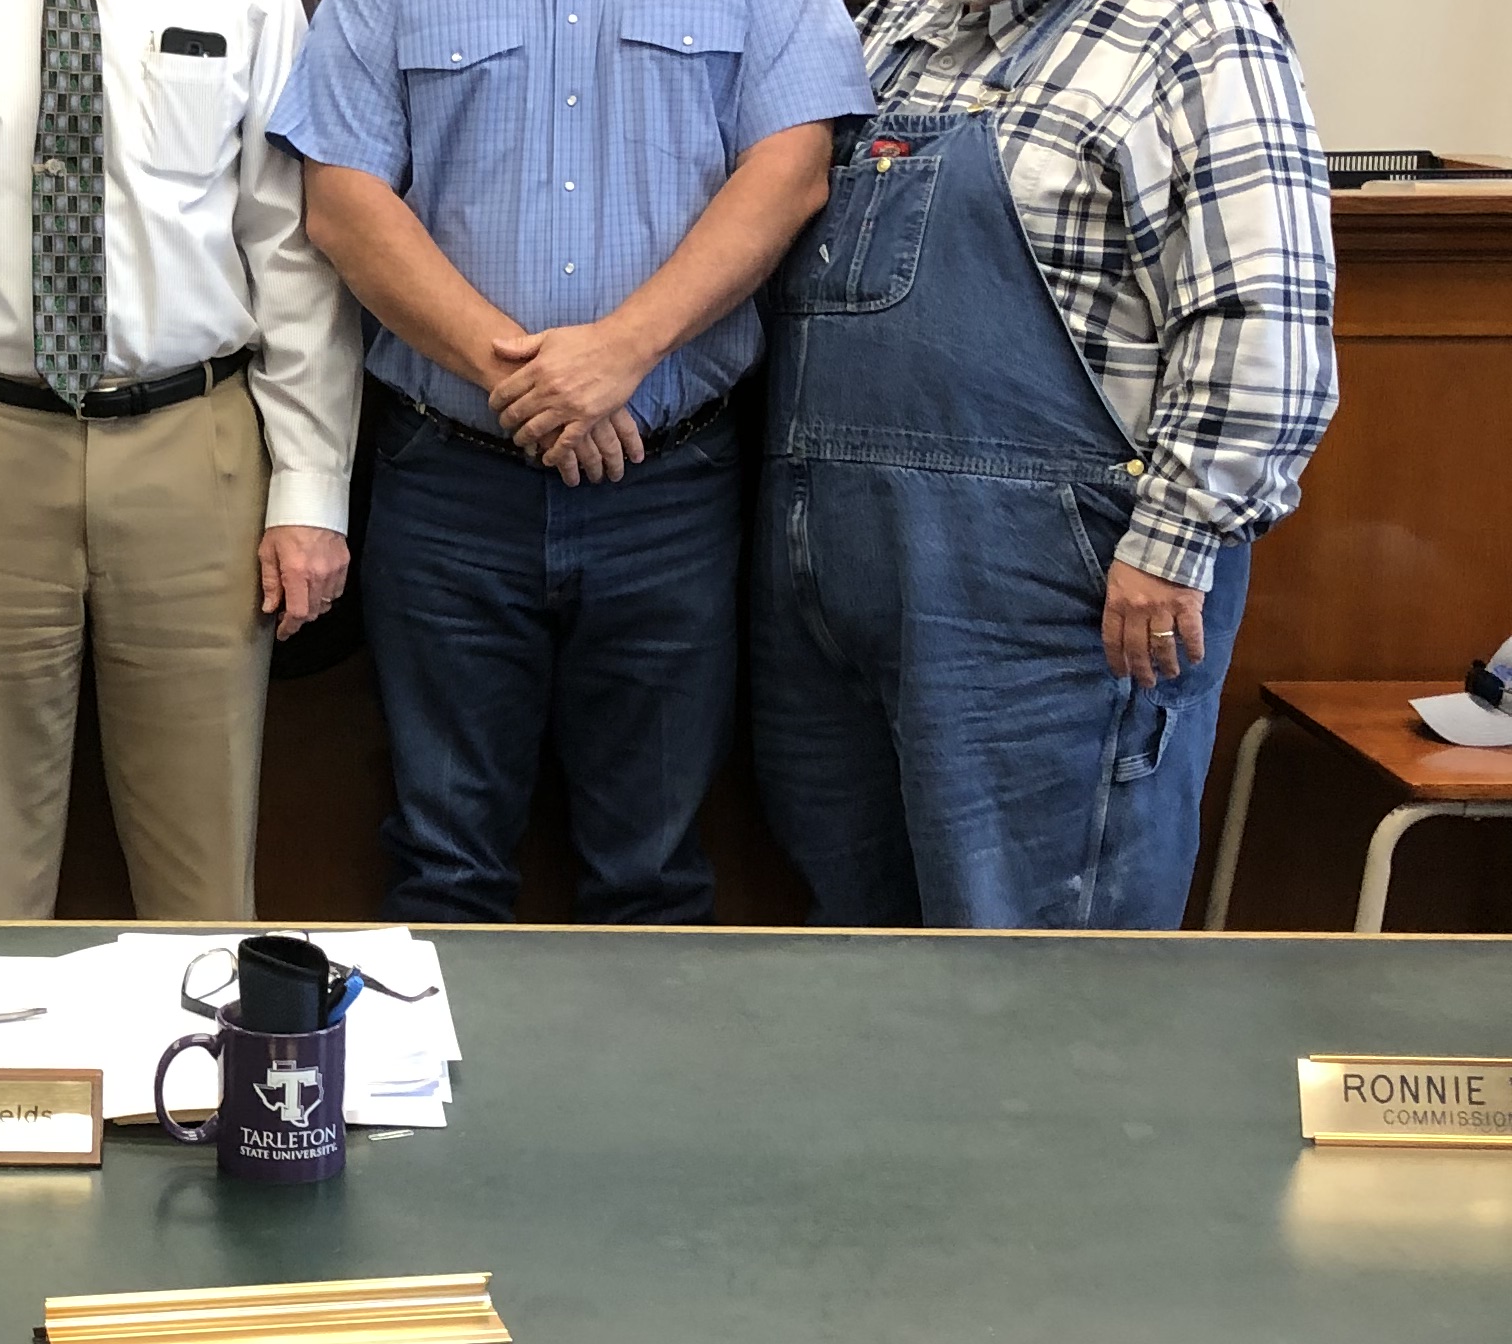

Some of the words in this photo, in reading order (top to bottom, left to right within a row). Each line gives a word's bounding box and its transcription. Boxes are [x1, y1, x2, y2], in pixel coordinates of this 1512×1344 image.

[1342, 1073, 1487, 1106] RONNIE
[1382, 1108, 1512, 1128] COMMISSIO
[239, 1123, 337, 1149] TARLETON
[239, 1145, 270, 1160] STATE
[272, 1143, 338, 1161] UNIVERSITY
